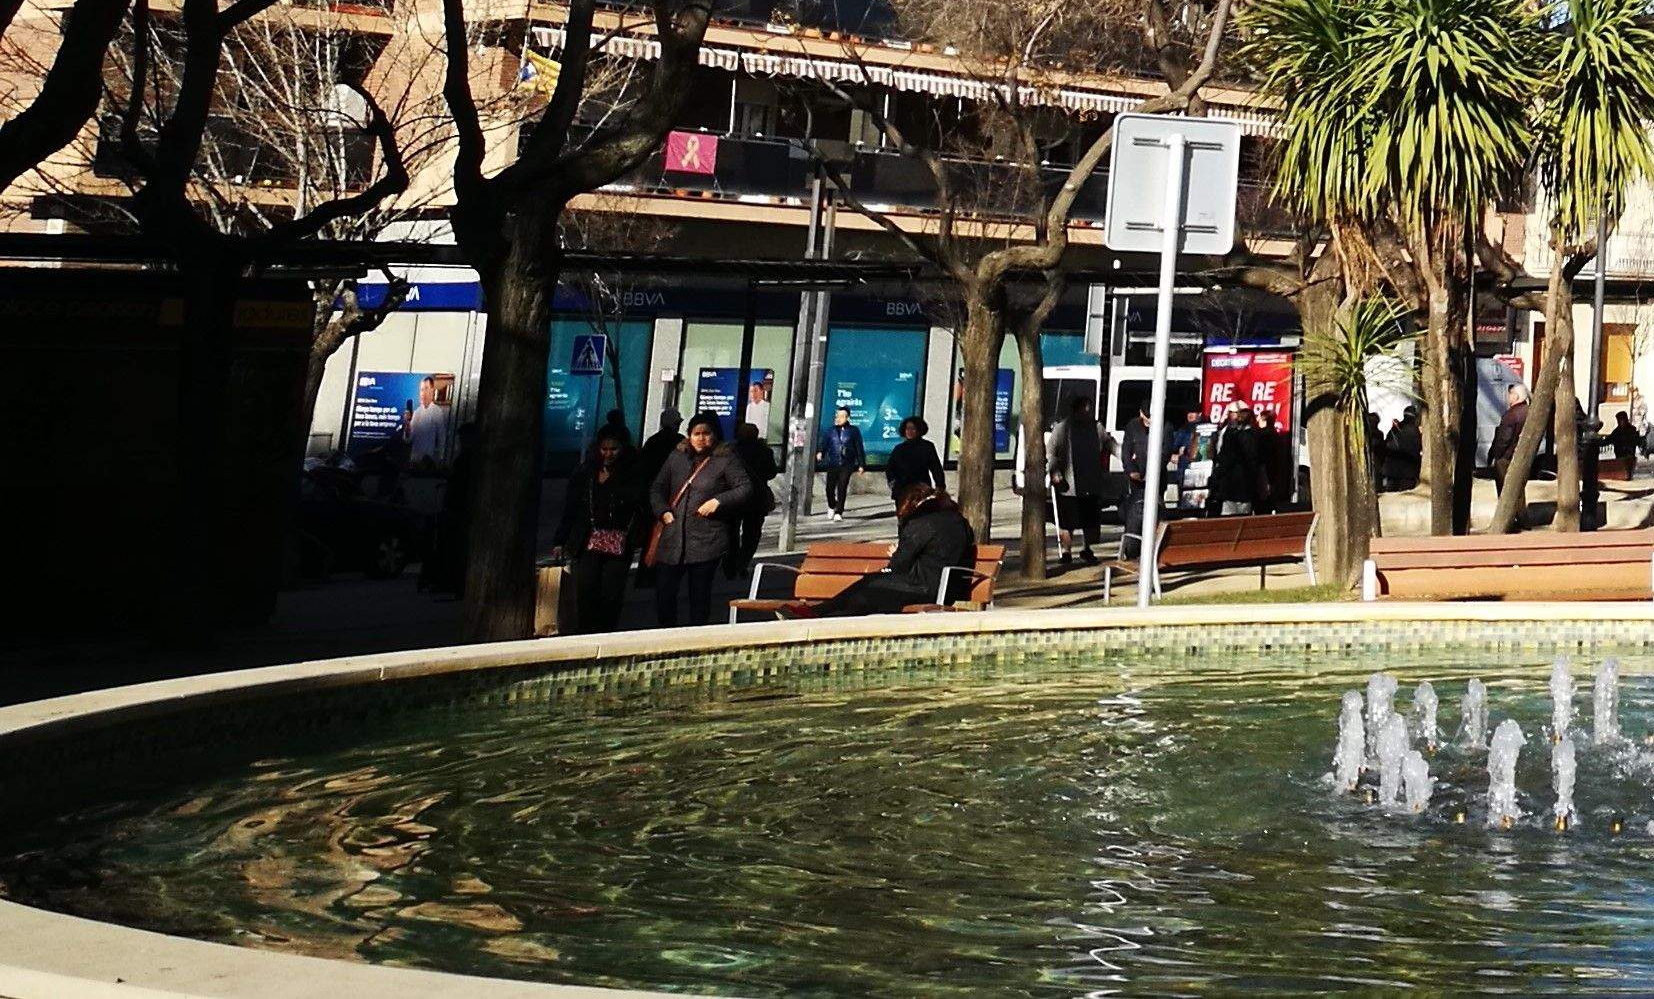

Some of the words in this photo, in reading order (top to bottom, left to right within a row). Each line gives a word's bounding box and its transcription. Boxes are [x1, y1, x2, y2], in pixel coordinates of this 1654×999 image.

[623, 292, 665, 306] BBVA
[886, 302, 923, 316] BBVA
[1209, 383, 1236, 403] RE
[1251, 381, 1278, 402] RE
